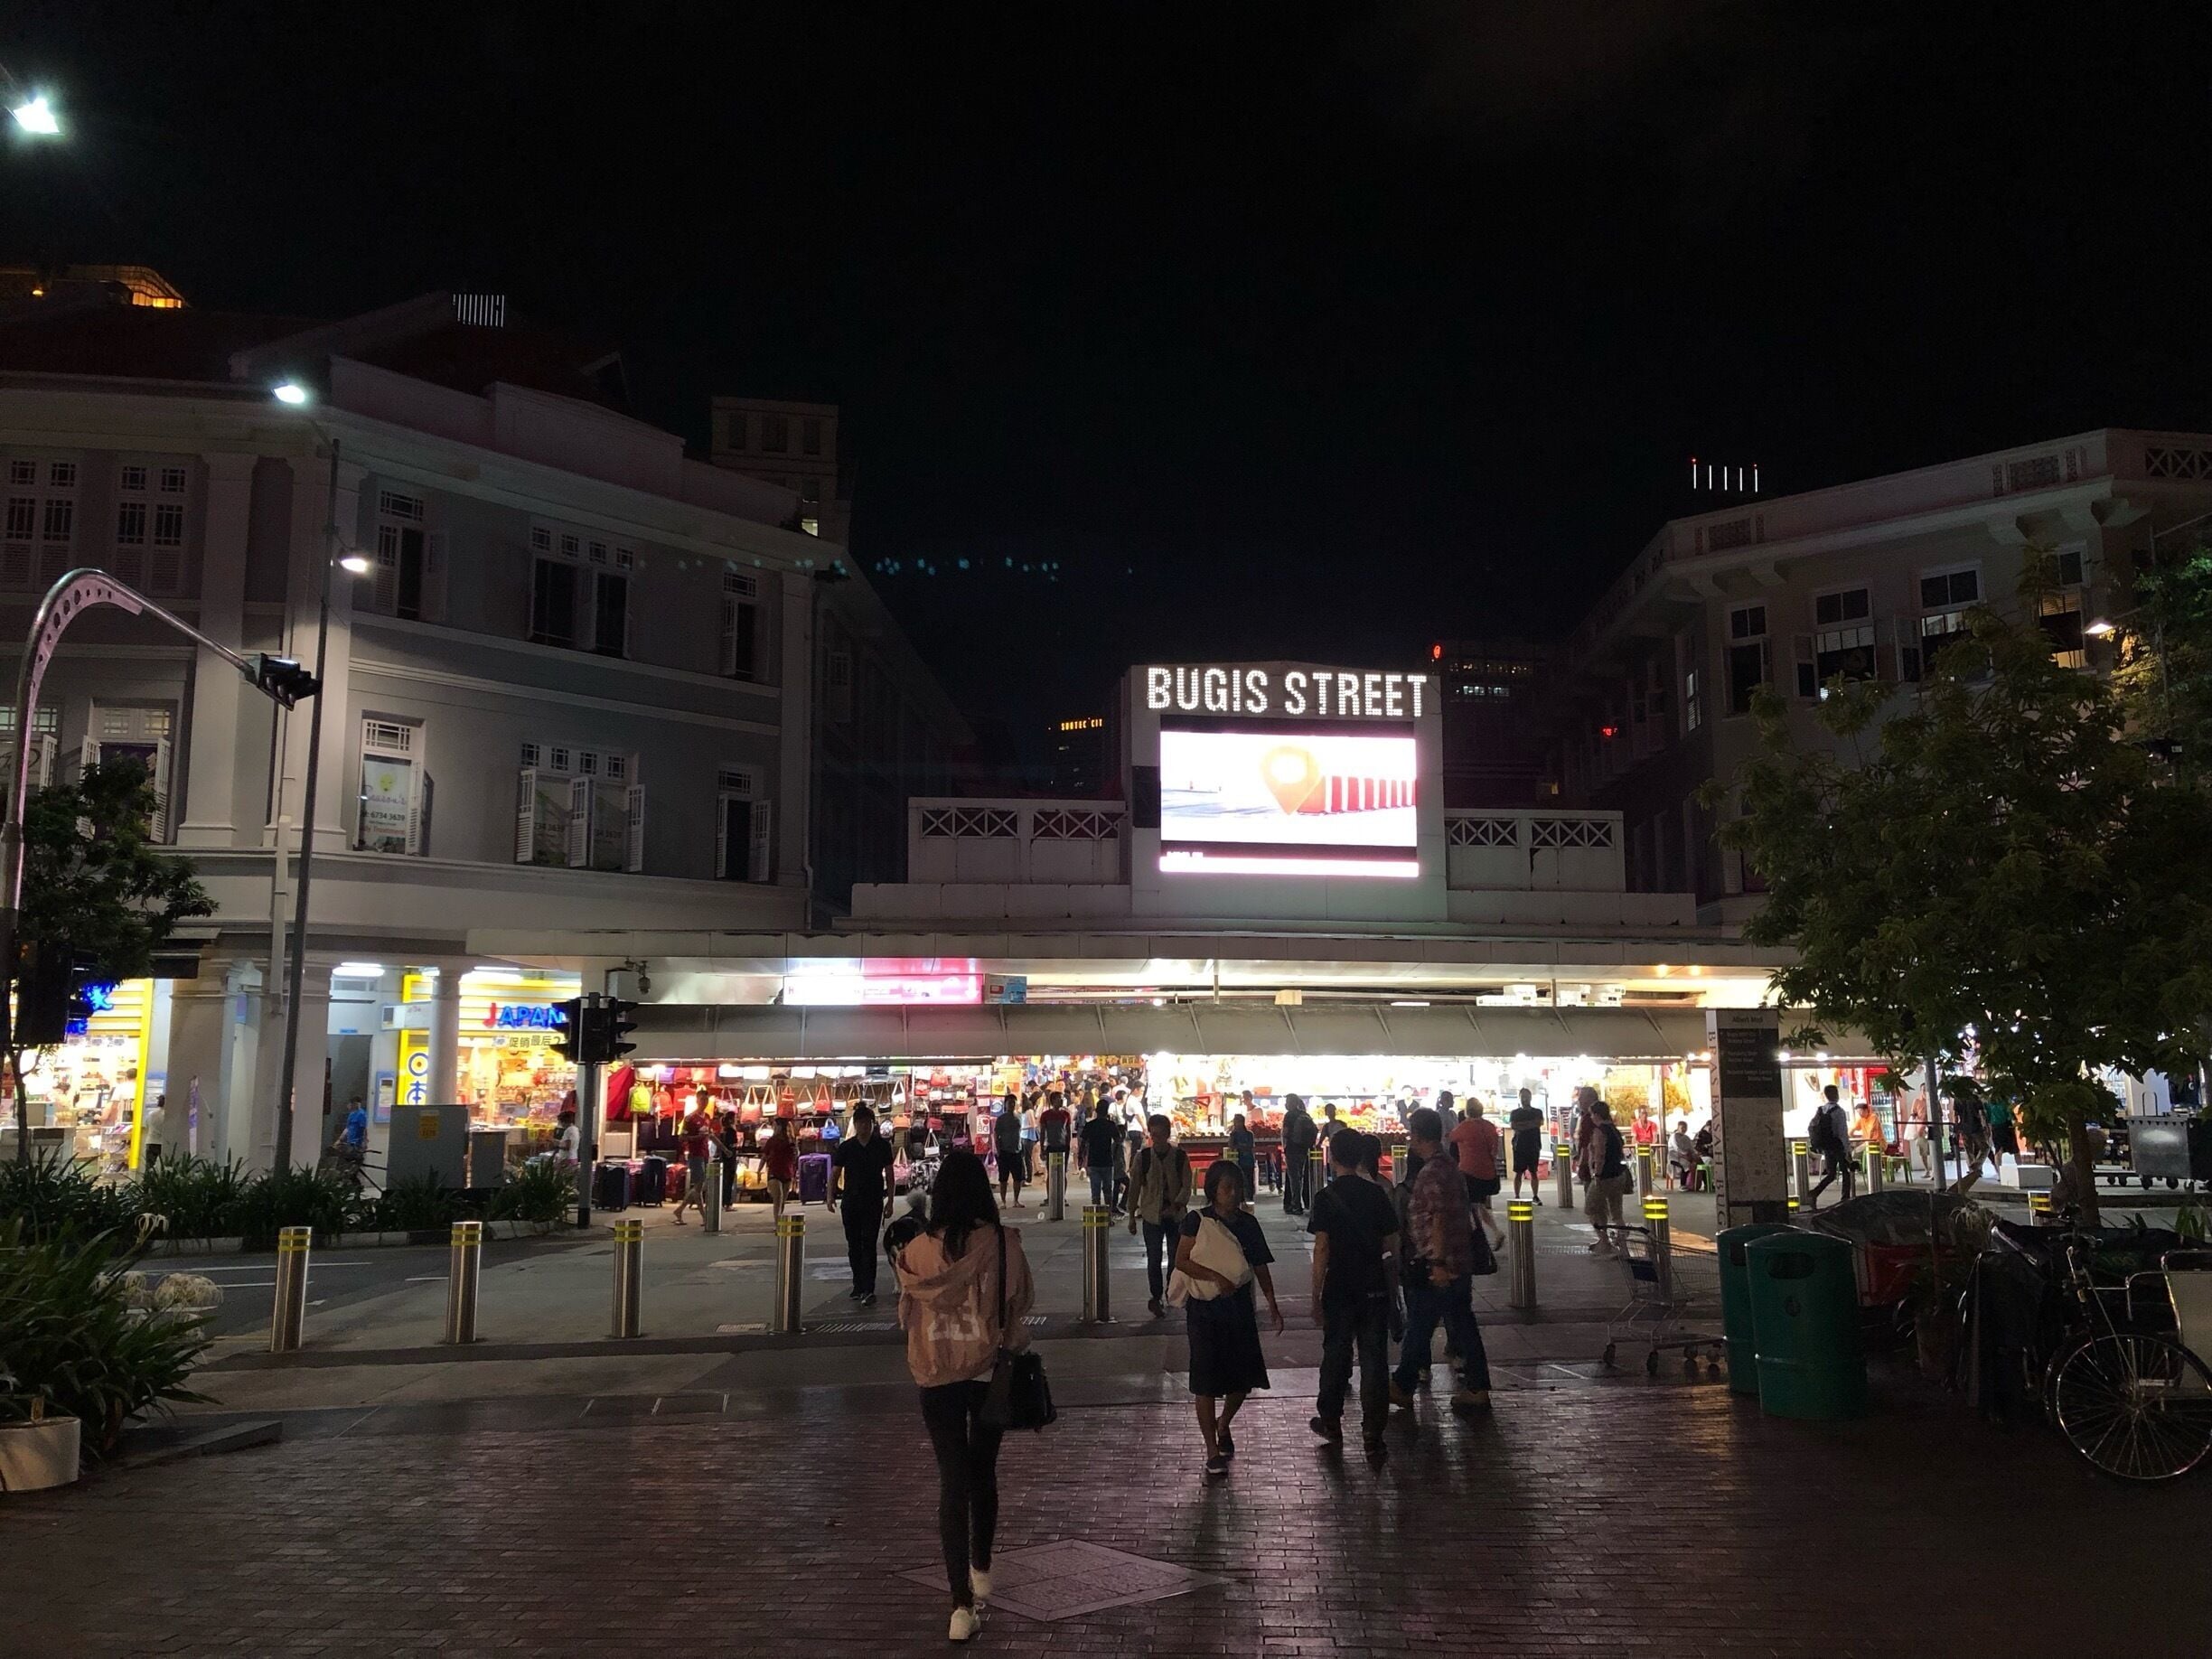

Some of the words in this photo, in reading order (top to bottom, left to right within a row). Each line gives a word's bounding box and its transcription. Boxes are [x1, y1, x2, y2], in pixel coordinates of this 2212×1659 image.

[1147, 667, 1269, 714] BUGIS
[1285, 671, 1428, 717] STREET
[483, 1002, 565, 1028] JAPAN
[1711, 1094, 1723, 1166] BASAH
